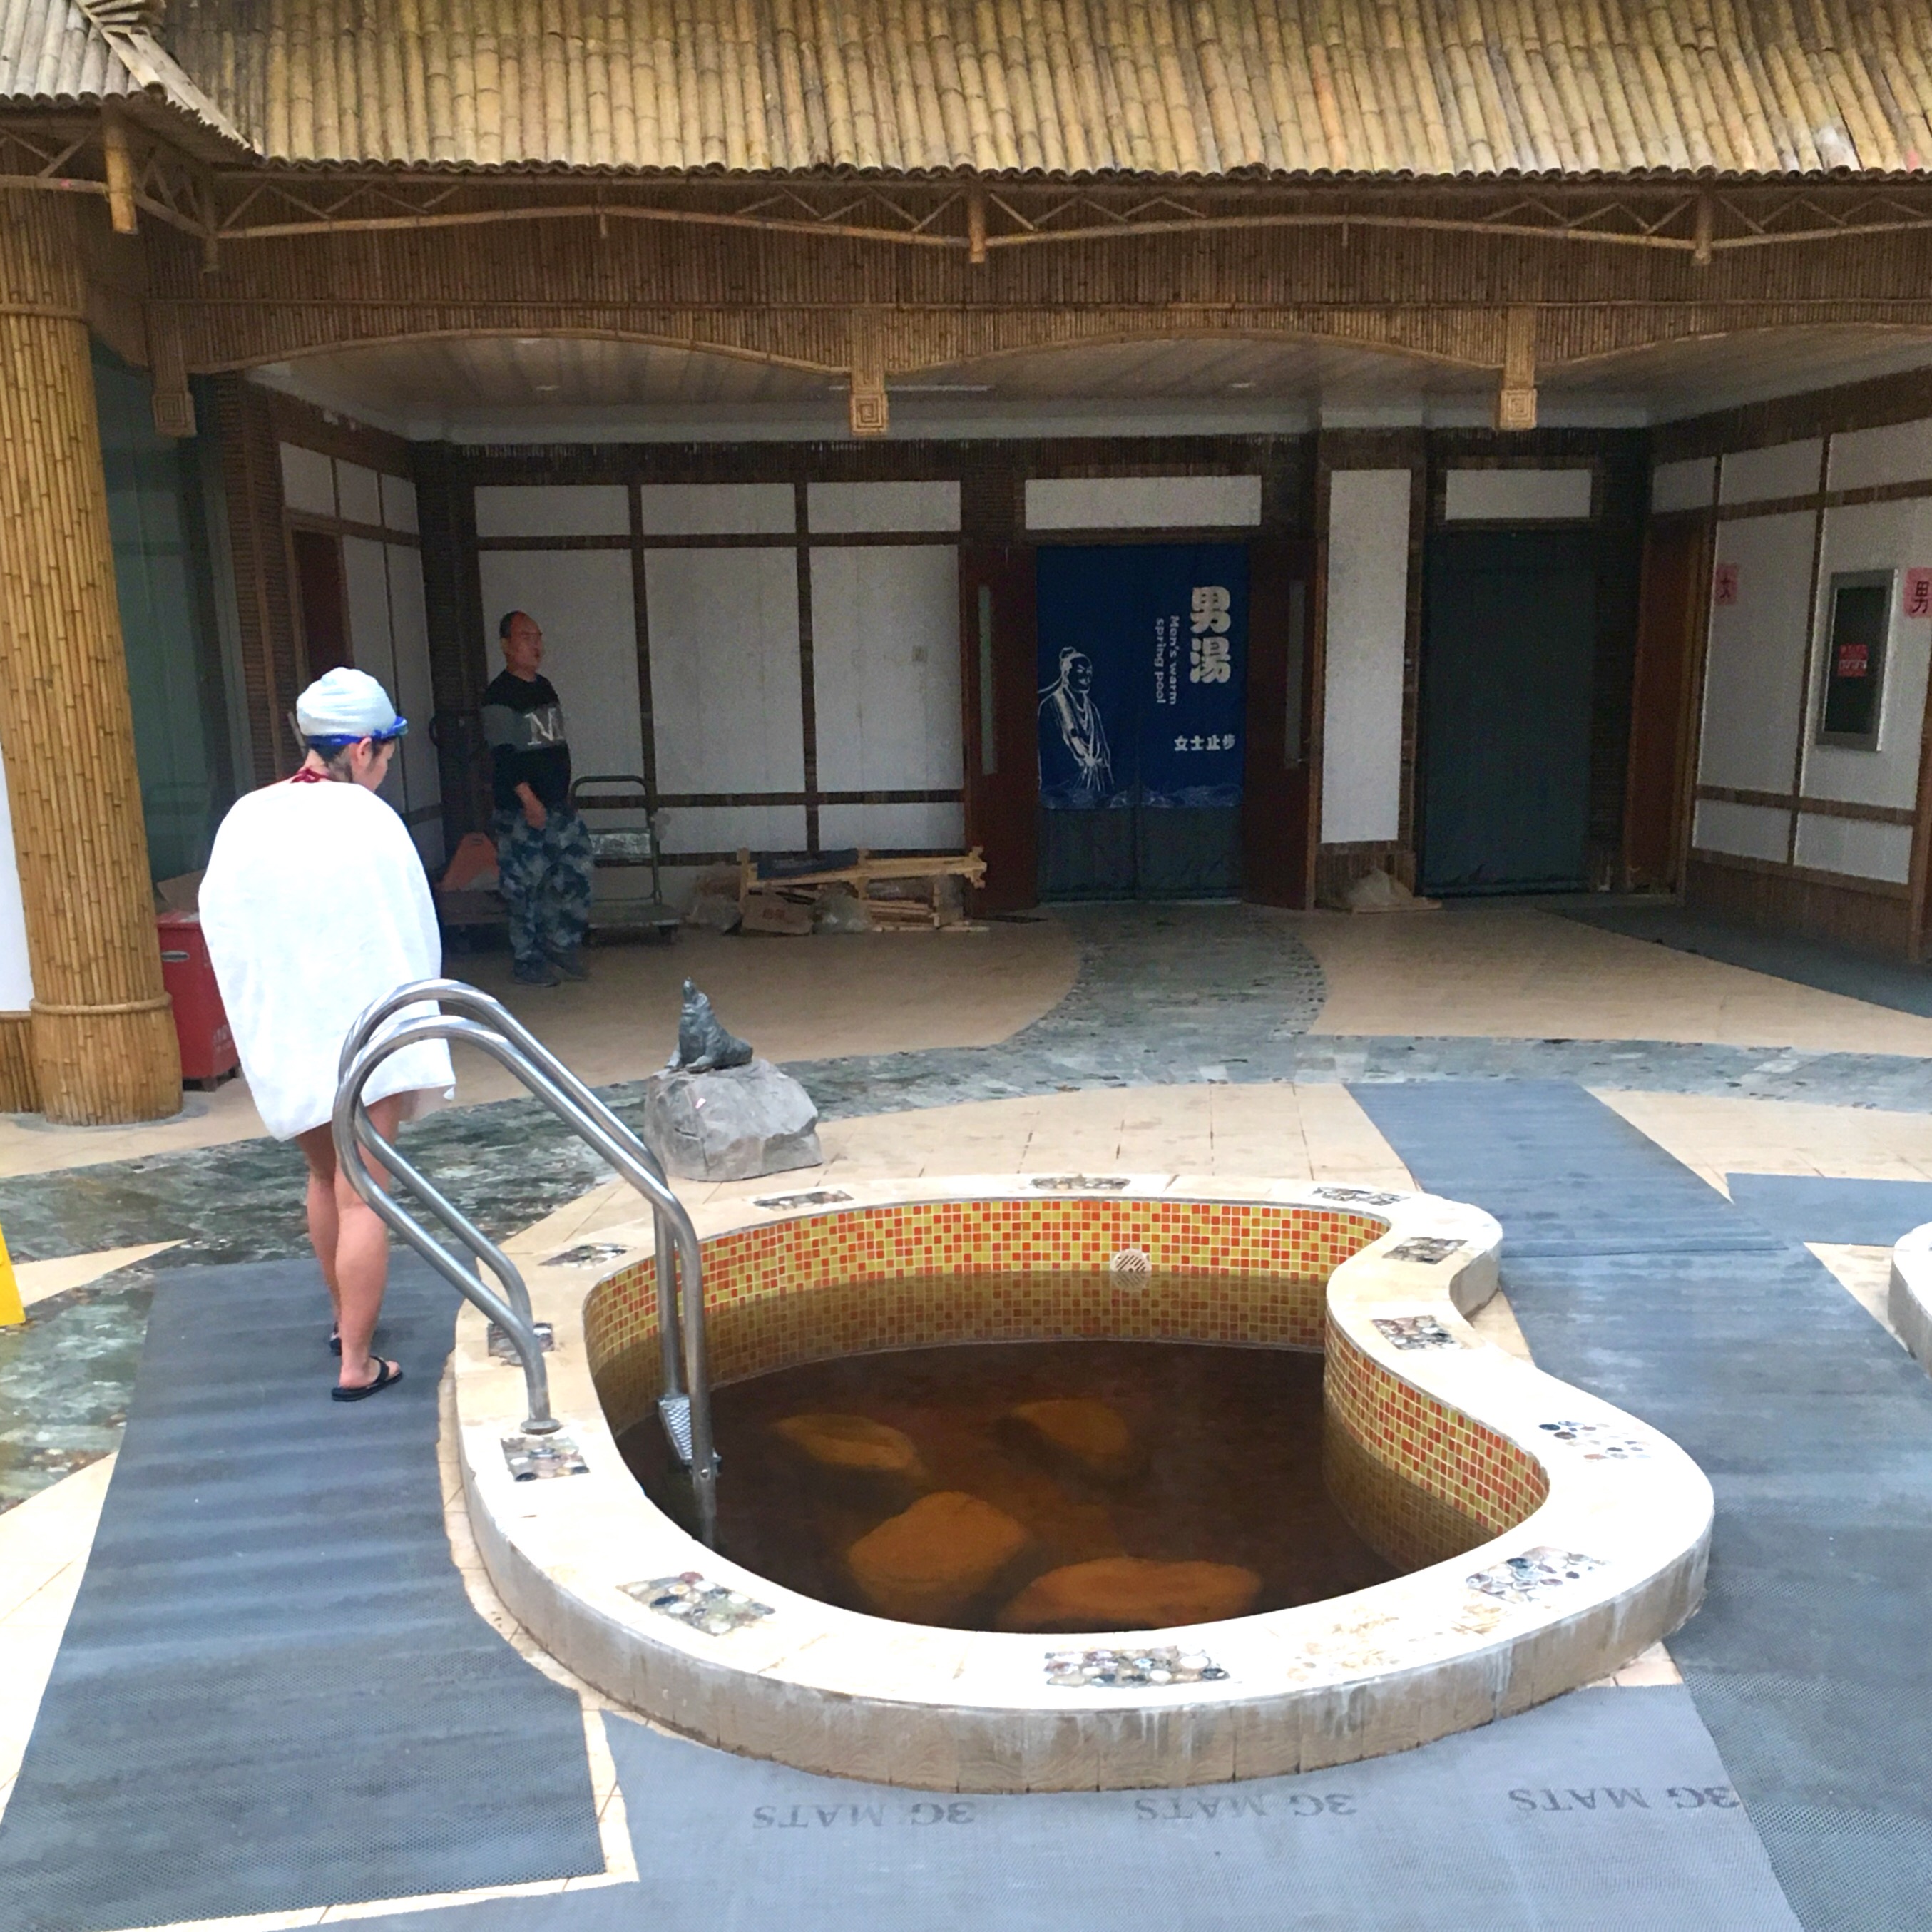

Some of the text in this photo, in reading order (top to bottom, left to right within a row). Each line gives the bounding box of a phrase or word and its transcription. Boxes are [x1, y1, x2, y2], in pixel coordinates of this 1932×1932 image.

[1911, 580, 1930, 614] 男
[1154, 618, 1167, 704] spring pool
[1169, 615, 1180, 705] Men's warm
[1174, 733, 1236, 752] 女士止步
[1135, 1793, 1358, 1820] 3G MATS
[1508, 1786, 1741, 1811] 3G MATS
[752, 1801, 977, 1829] 3G MATS
